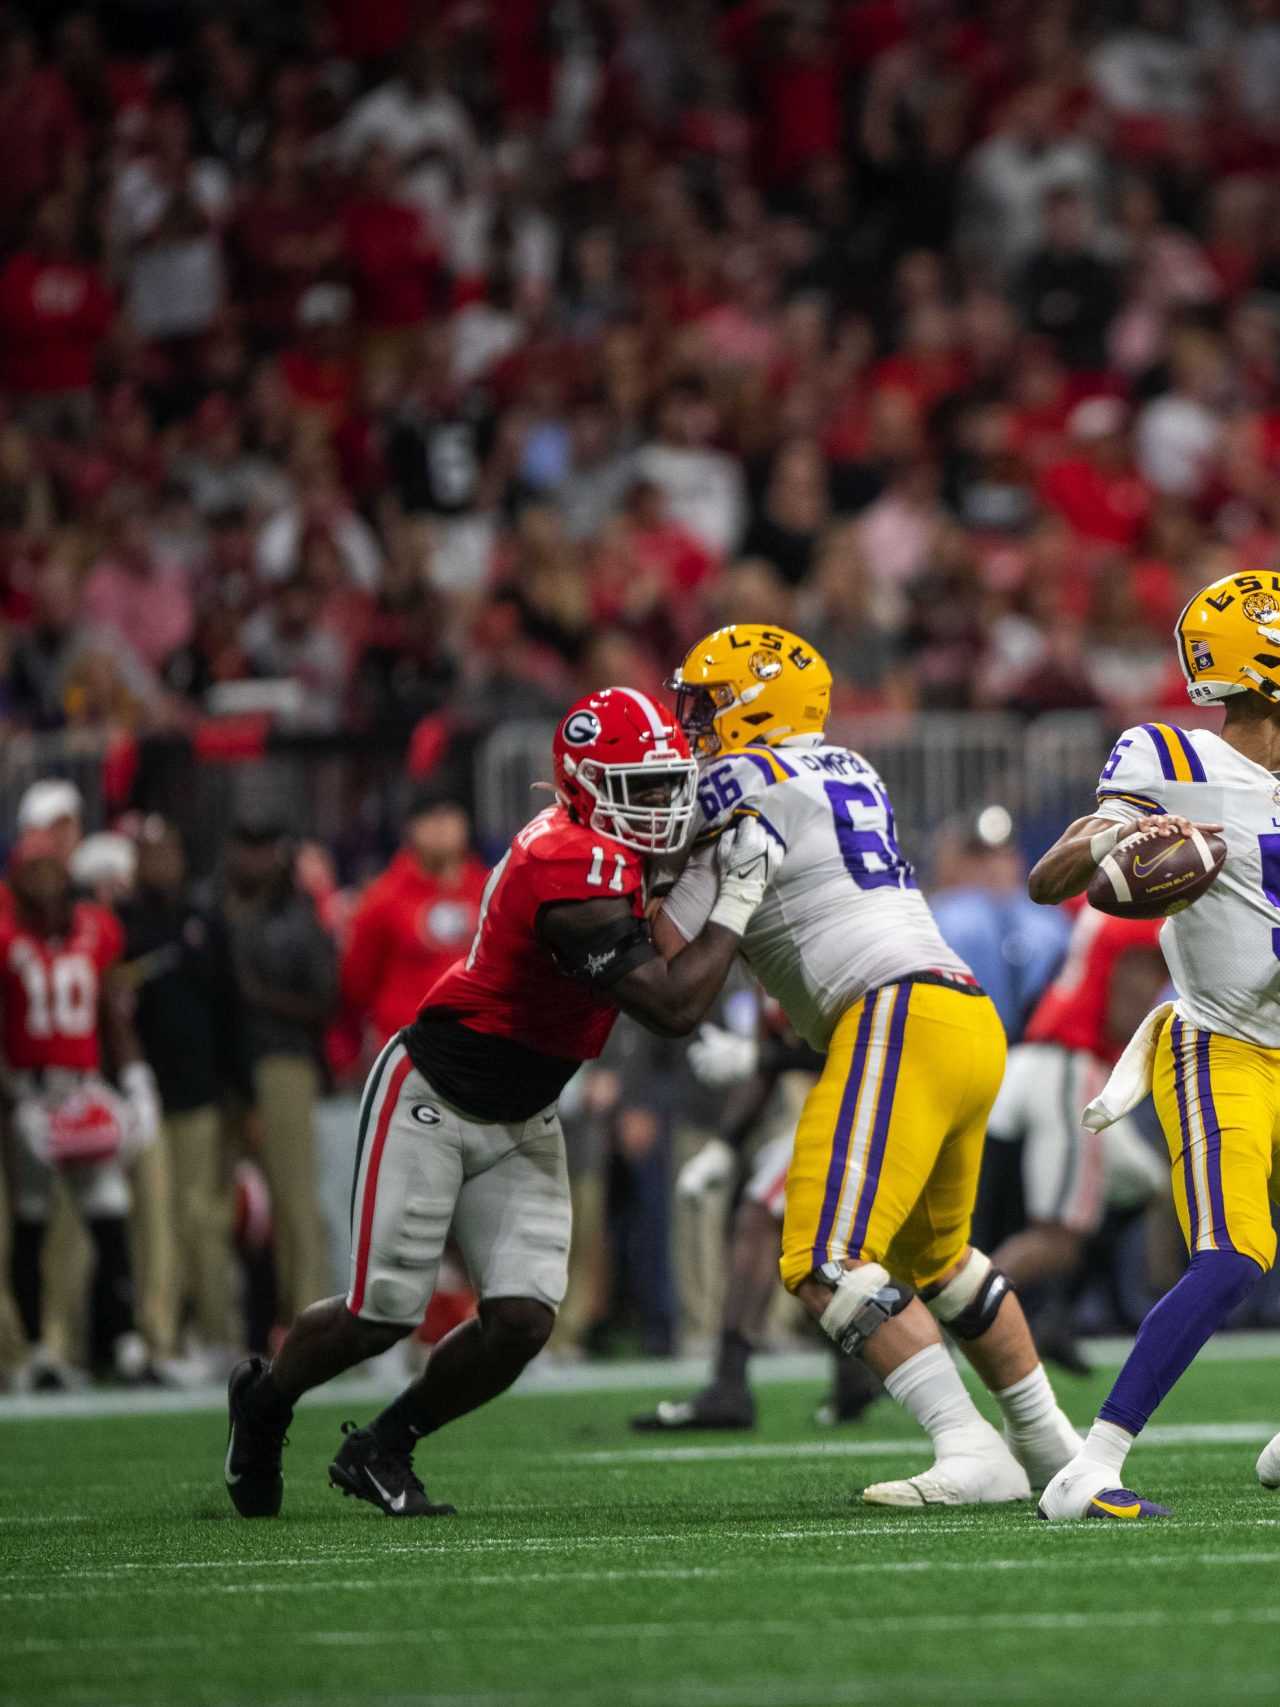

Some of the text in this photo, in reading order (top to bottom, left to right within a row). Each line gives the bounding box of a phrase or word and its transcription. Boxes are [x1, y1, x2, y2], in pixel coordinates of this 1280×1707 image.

[563, 711, 601, 744] G
[1101, 739, 1134, 780] 5
[696, 764, 743, 821] 66
[587, 846, 627, 892] 11
[7, 936, 97, 1039] 10
[410, 1103, 441, 1125] G
